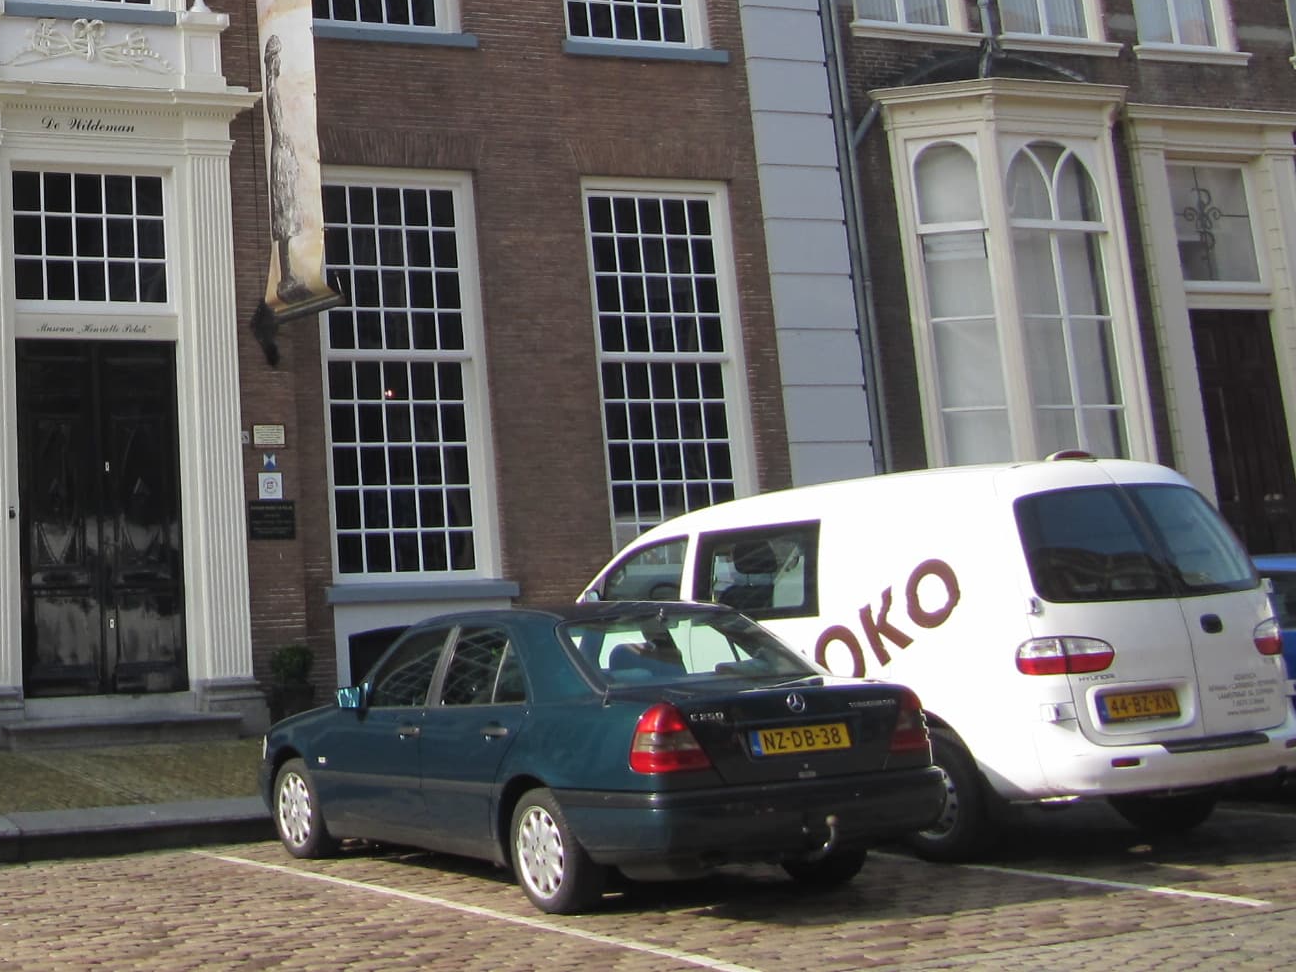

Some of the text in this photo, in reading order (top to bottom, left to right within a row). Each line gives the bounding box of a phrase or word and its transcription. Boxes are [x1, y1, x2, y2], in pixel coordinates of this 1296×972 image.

[41, 115, 135, 133] De Wildeman
[36, 322, 74, 333] Museum
[801, 558, 961, 678] OKO
[764, 728, 841, 751] NZ-DB-38
